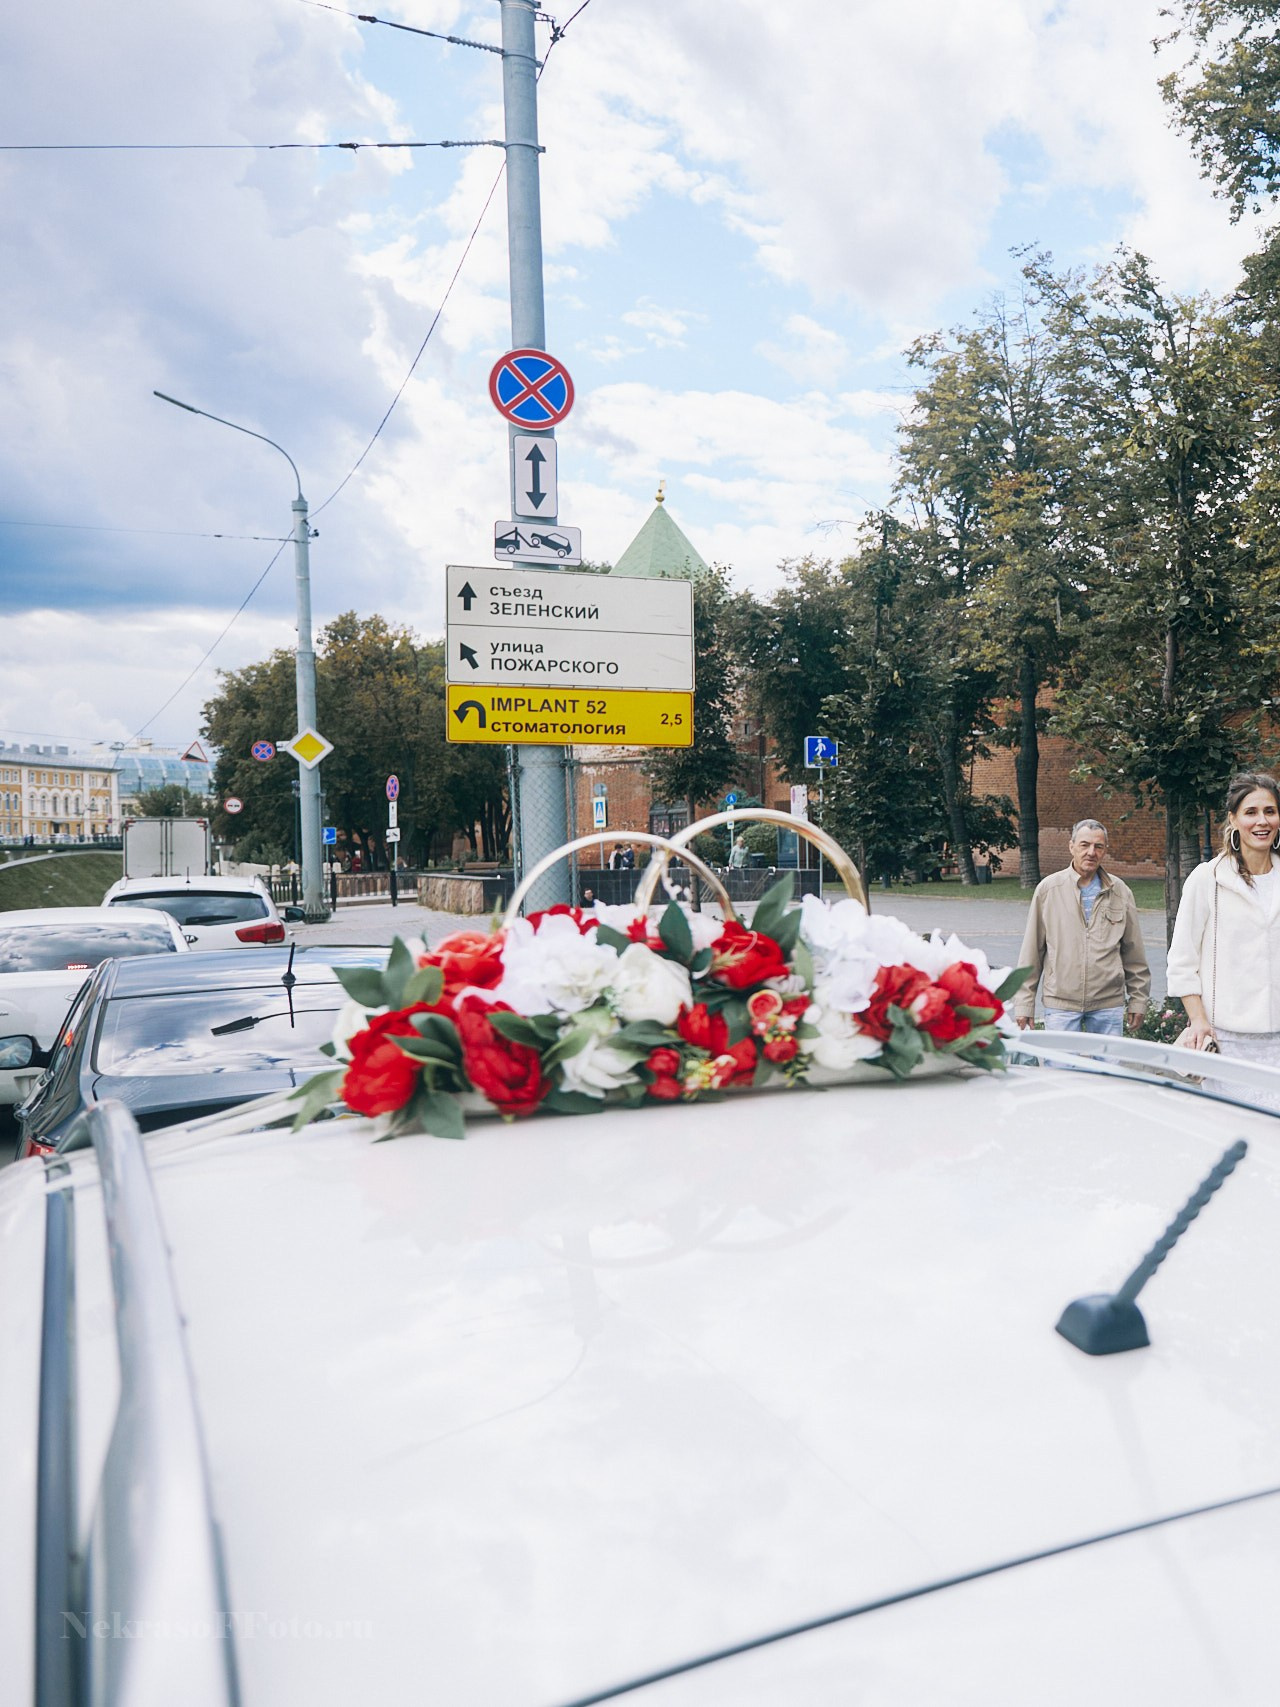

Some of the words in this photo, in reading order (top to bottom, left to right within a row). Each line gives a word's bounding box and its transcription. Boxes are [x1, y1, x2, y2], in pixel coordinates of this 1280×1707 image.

[489, 586, 543, 600] съезд
[489, 602, 599, 620] ЗЕЛЕНСКИЙ
[490, 642, 544, 655] улица
[491, 658, 619, 675] ПОЖАРСКОГО
[490, 697, 580, 714] IMPLANT
[586, 700, 607, 715] 52
[491, 720, 626, 735] стоматология
[660, 713, 683, 728] 2,5
